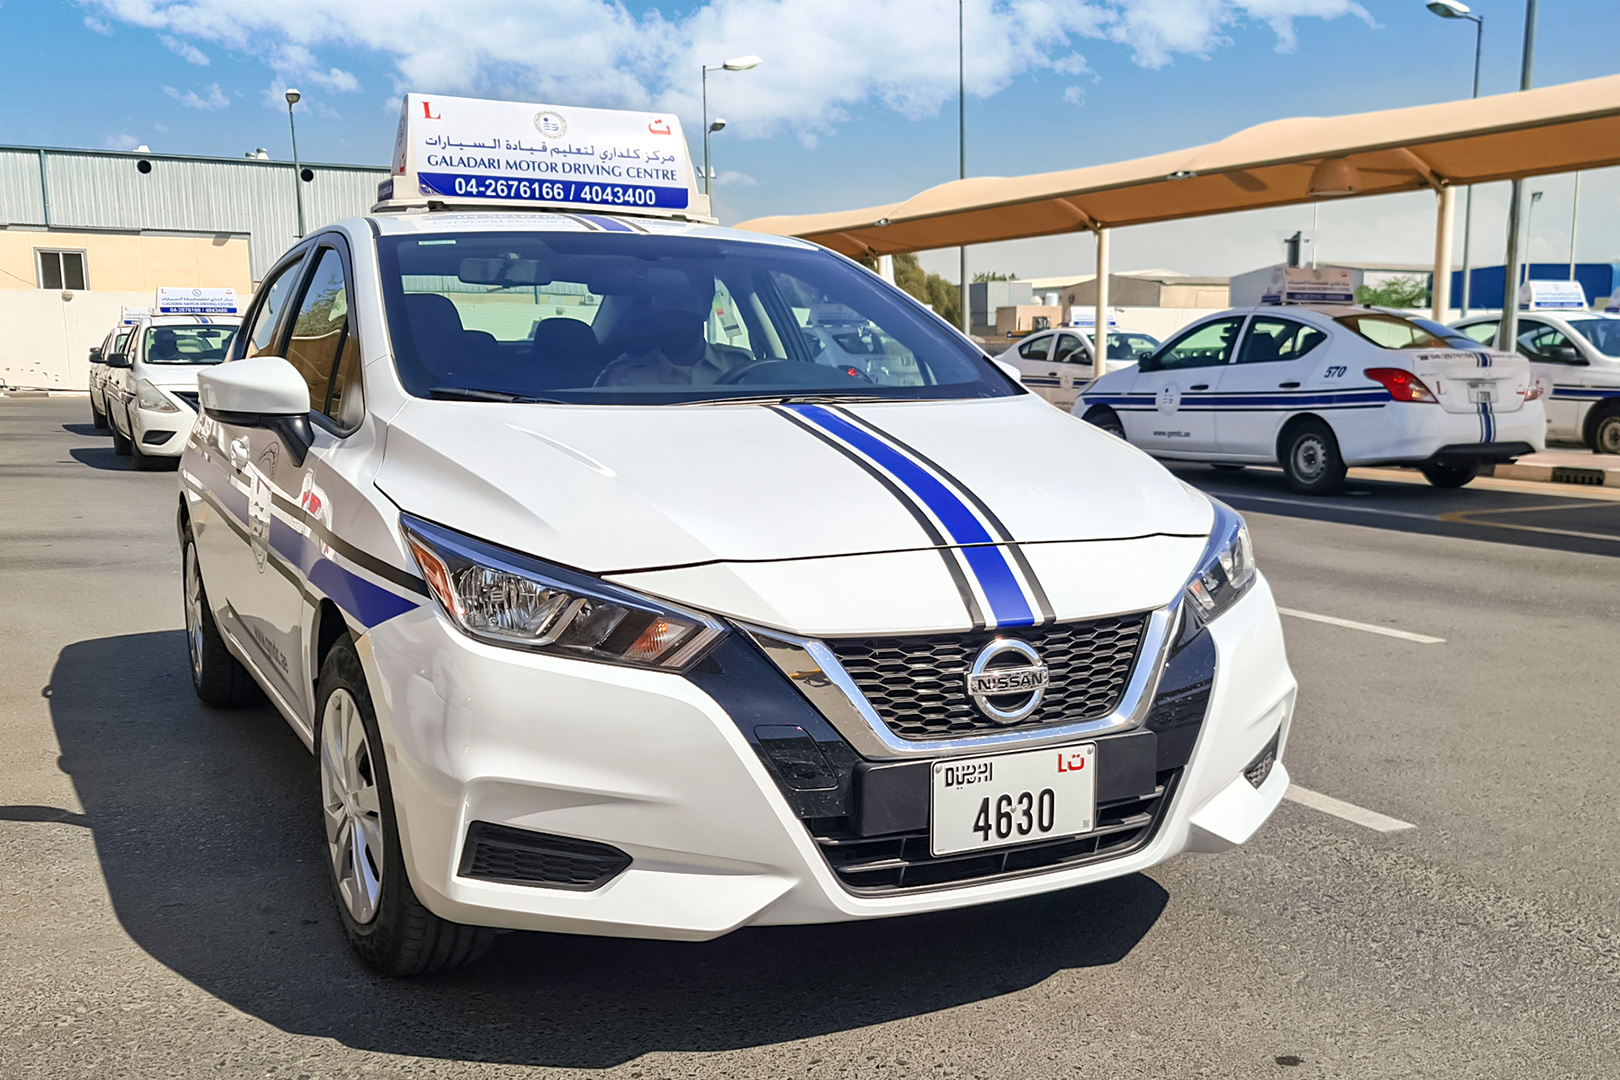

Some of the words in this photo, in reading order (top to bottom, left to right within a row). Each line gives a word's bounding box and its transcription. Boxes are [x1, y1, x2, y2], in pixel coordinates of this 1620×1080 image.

[420, 101, 441, 120] L
[425, 134, 501, 150] السيارات
[505, 139, 548, 155] قيادة
[550, 143, 595, 157] لتعليم
[599, 147, 641, 163] كلداري
[644, 149, 676, 165] مركز
[427, 154, 501, 170] GALADARI
[505, 159, 559, 173] MOTOR
[562, 162, 622, 178] DRIVING
[626, 166, 677, 181] CENTRE
[455, 177, 564, 199] 04-2676166
[580, 185, 656, 205] 4043400
[1323, 365, 1347, 378] 570
[977, 672, 1043, 690] NISSAN
[973, 787, 1055, 842] 4630
